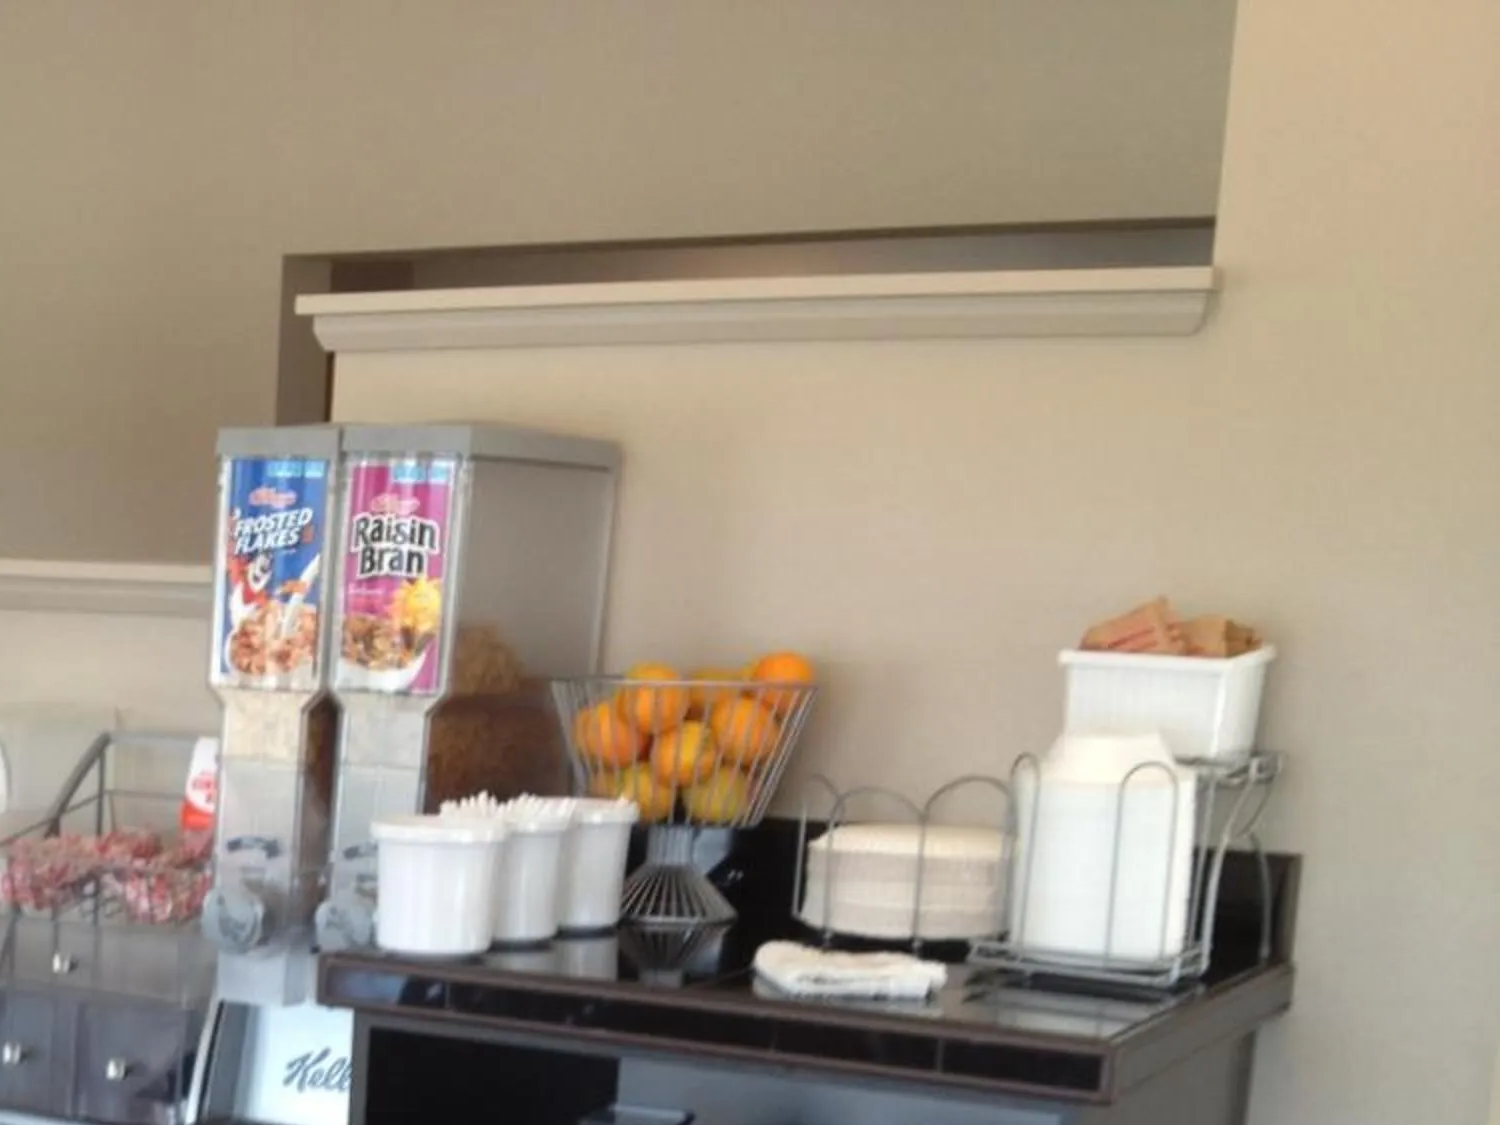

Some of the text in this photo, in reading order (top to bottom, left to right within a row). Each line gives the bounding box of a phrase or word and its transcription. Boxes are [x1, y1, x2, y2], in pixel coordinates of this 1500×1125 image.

[234, 507, 314, 538] FROSTED
[354, 516, 437, 550] Raisin
[234, 526, 301, 555] FLAKES
[359, 545, 425, 575] Bran
[282, 1046, 353, 1093] Kell
